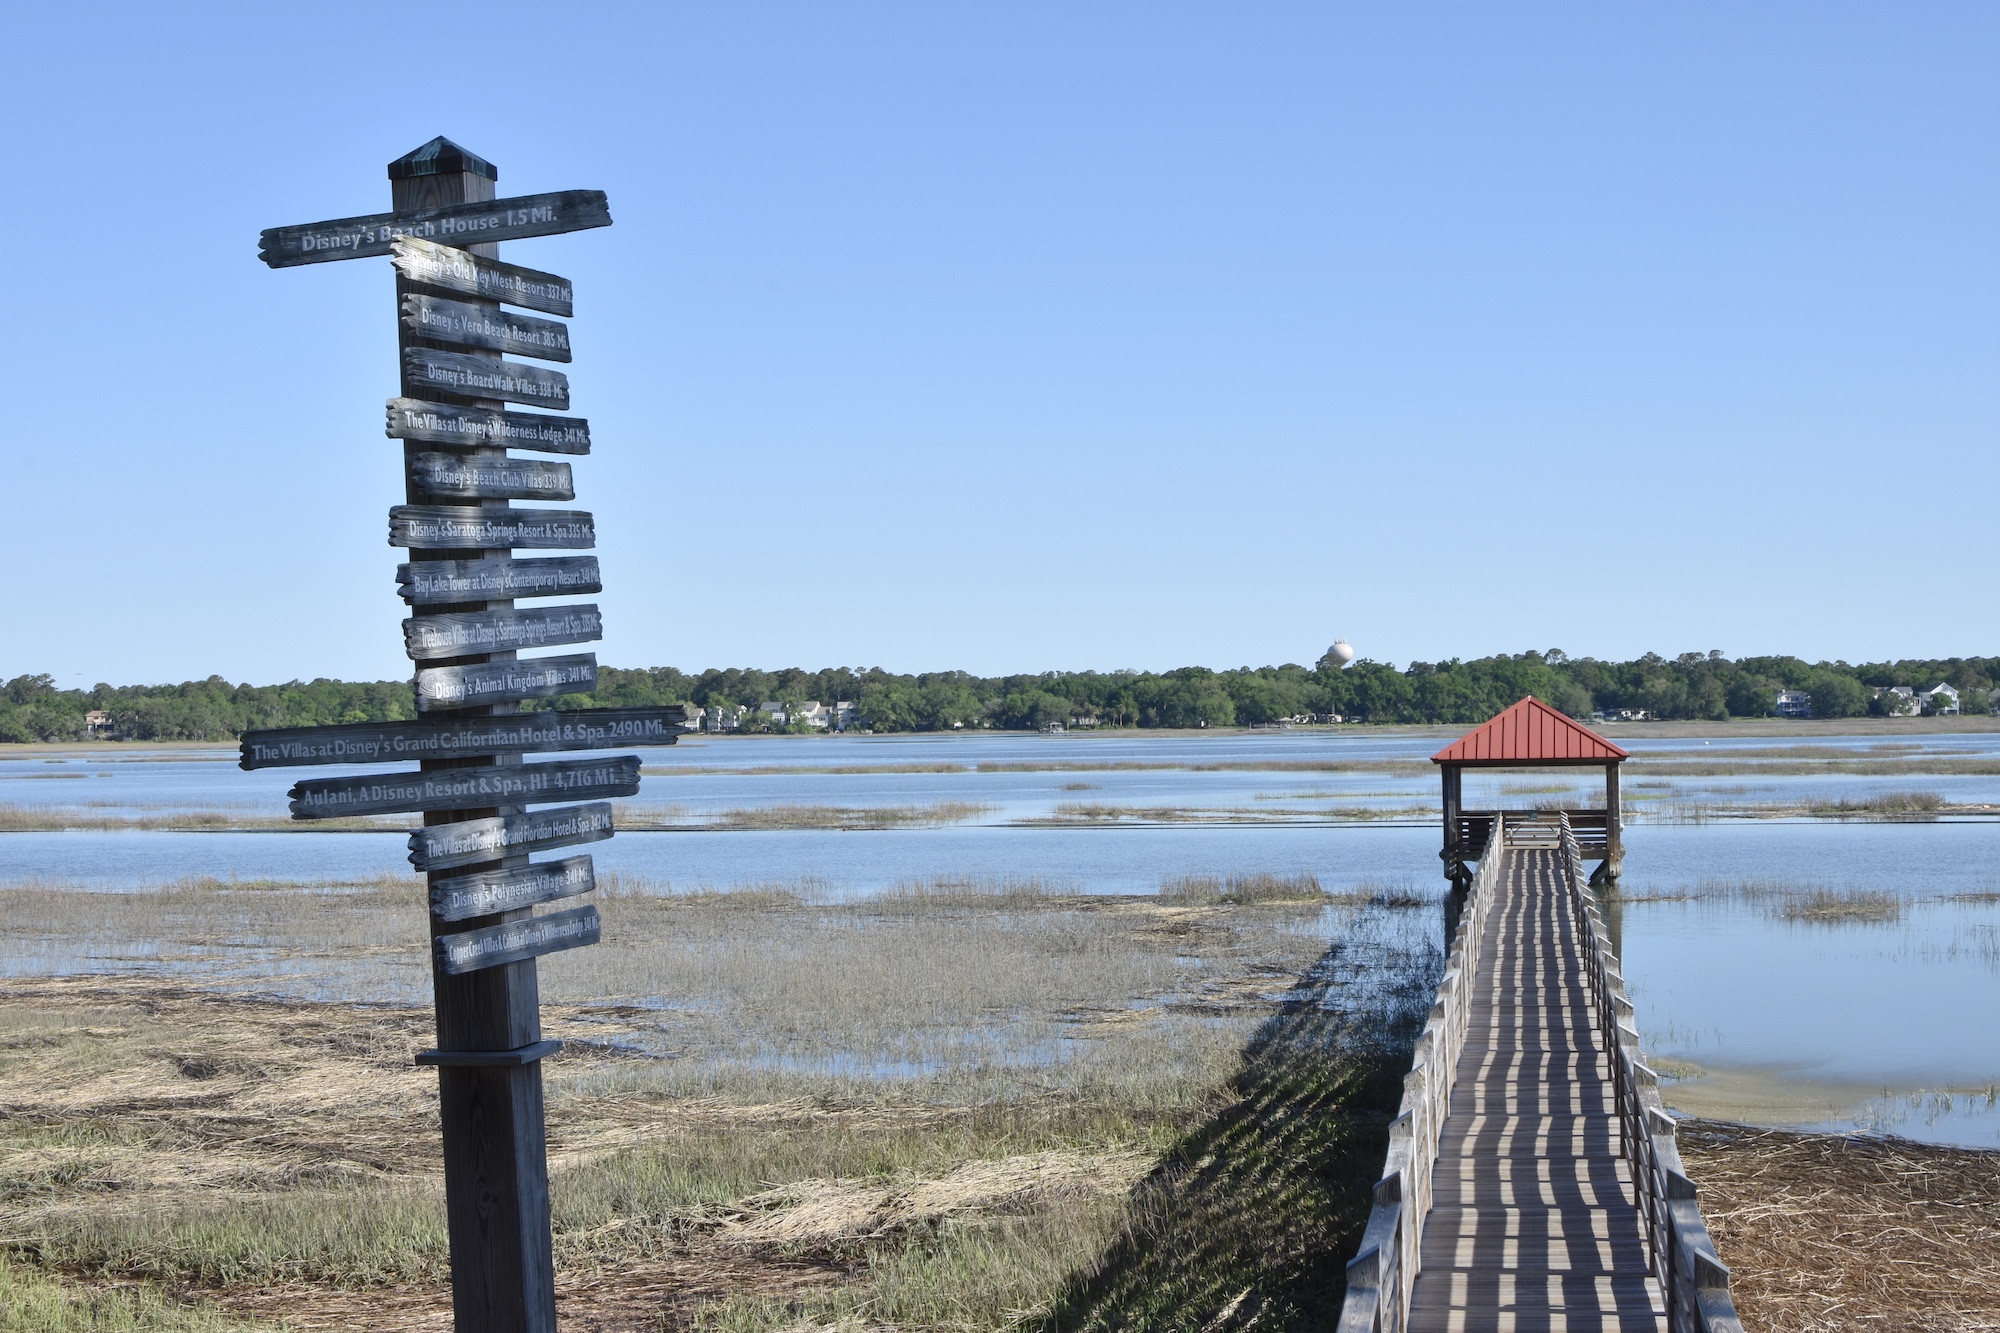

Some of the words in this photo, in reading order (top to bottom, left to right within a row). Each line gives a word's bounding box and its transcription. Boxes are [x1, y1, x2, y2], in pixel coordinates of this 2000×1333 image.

[302, 225, 374, 251] Disney's
[441, 217, 499, 235] House
[507, 210, 528, 227] 1.5
[531, 206, 557, 224] Mi.
[411, 252, 450, 277] Disney's
[453, 262, 470, 280] Old
[473, 267, 490, 288] Key
[490, 270, 513, 290] West
[515, 276, 545, 297] Resort
[547, 284, 560, 300] 337
[422, 308, 459, 333] Disney's
[461, 316, 482, 334] Vero
[484, 320, 511, 339] Beach
[512, 325, 540, 344] Resort
[542, 331, 555, 348] 385
[428, 363, 465, 388] Disney's
[467, 369, 514, 392] BoardWalk
[515, 377, 537, 395] Villas
[538, 382, 551, 397] 338
[405, 411, 423, 429] The
[422, 413, 446, 432] Villas
[445, 420, 457, 432] at
[458, 417, 494, 439] Disney's
[492, 419, 537, 439] Wilderness
[539, 425, 563, 445] Lodge
[564, 429, 576, 443] 341
[435, 466, 471, 489] Disney's
[472, 469, 499, 487] Beach
[501, 471, 520, 487] Club
[521, 473, 543, 489] Villas
[544, 474, 557, 488] 339
[409, 517, 447, 542] Disney's
[446, 521, 486, 542] Saratoga
[487, 522, 517, 542] Springs
[518, 523, 544, 538] Resort
[545, 524, 552, 538] &
[552, 524, 567, 543] Spa
[568, 524, 580, 539] 335
[414, 576, 429, 597] Bay
[429, 575, 448, 593] Lake
[447, 574, 471, 592] Tower
[472, 578, 480, 590] at
[480, 568, 510, 594] Disney's
[508, 571, 558, 590] Contemporary
[558, 569, 580, 585] Resort
[580, 568, 591, 583] 341
[435, 676, 473, 700] Disney's
[475, 674, 505, 694] Animal
[507, 673, 544, 693] Kingdom
[545, 670, 566, 685] Villas
[568, 667, 579, 682] 341
[252, 745, 279, 761] The
[280, 742, 317, 759] Villas
[319, 743, 334, 757] at
[334, 734, 390, 758] Disney's
[393, 734, 438, 752] Grand
[440, 729, 518, 748] Californian
[520, 725, 561, 743] Hotel
[564, 725, 575, 741] &
[577, 724, 605, 744] Spa
[608, 720, 643, 738] 2490
[645, 718, 667, 736] Mi.
[304, 786, 357, 806] Aulani,
[359, 786, 370, 801] A
[372, 784, 422, 802] Disney
[425, 780, 475, 797] Resort
[479, 776, 492, 793] &
[493, 777, 527, 796] Spa,
[530, 773, 548, 791] HI
[452, 884, 490, 908] Disney's
[491, 879, 536, 903] Polynesian
[537, 875, 564, 892] Village
[565, 870, 577, 885] 341
